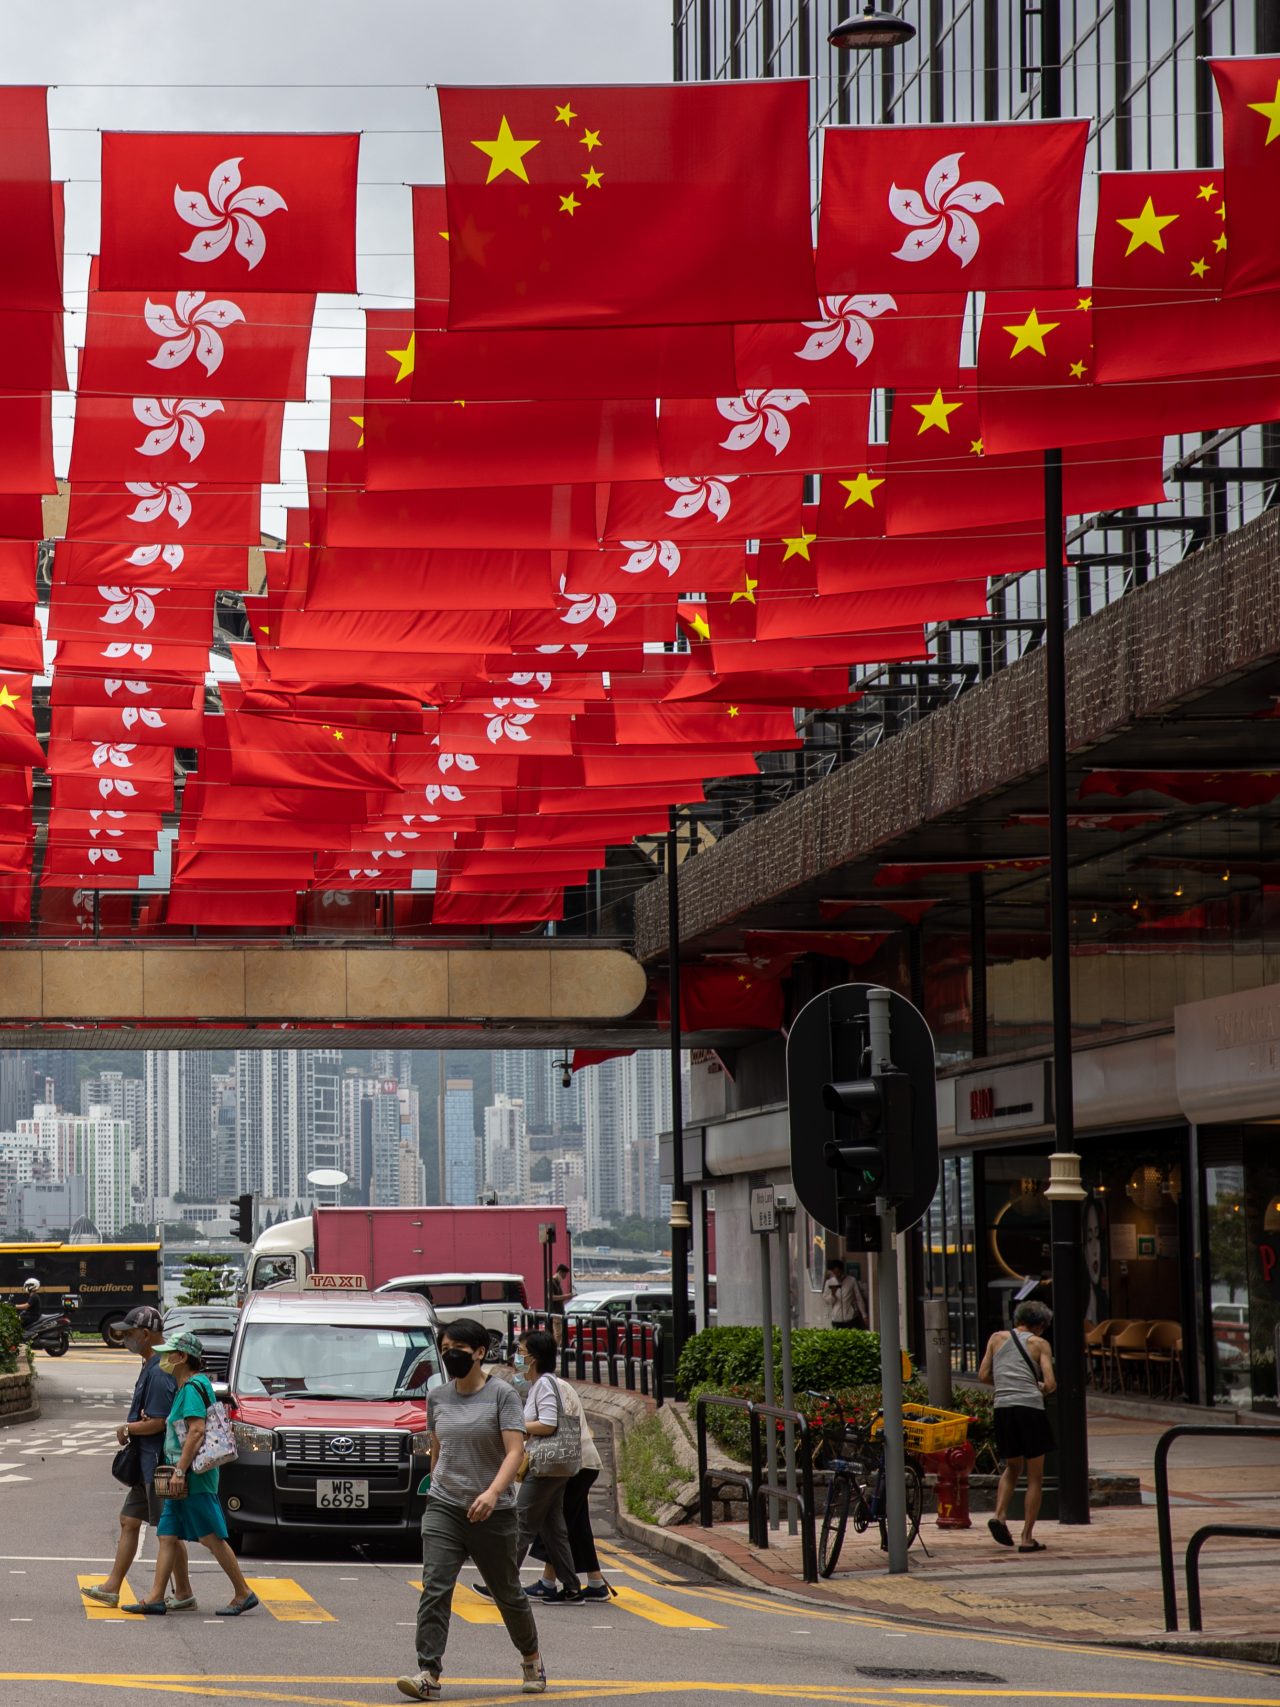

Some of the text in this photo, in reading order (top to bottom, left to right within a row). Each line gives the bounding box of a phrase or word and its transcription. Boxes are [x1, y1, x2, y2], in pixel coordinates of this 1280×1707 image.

[79, 1283, 133, 1292] Guardforce
[311, 1275, 363, 1288] TAXI
[332, 1481, 353, 1494] WR
[320, 1494, 365, 1508] 6695
